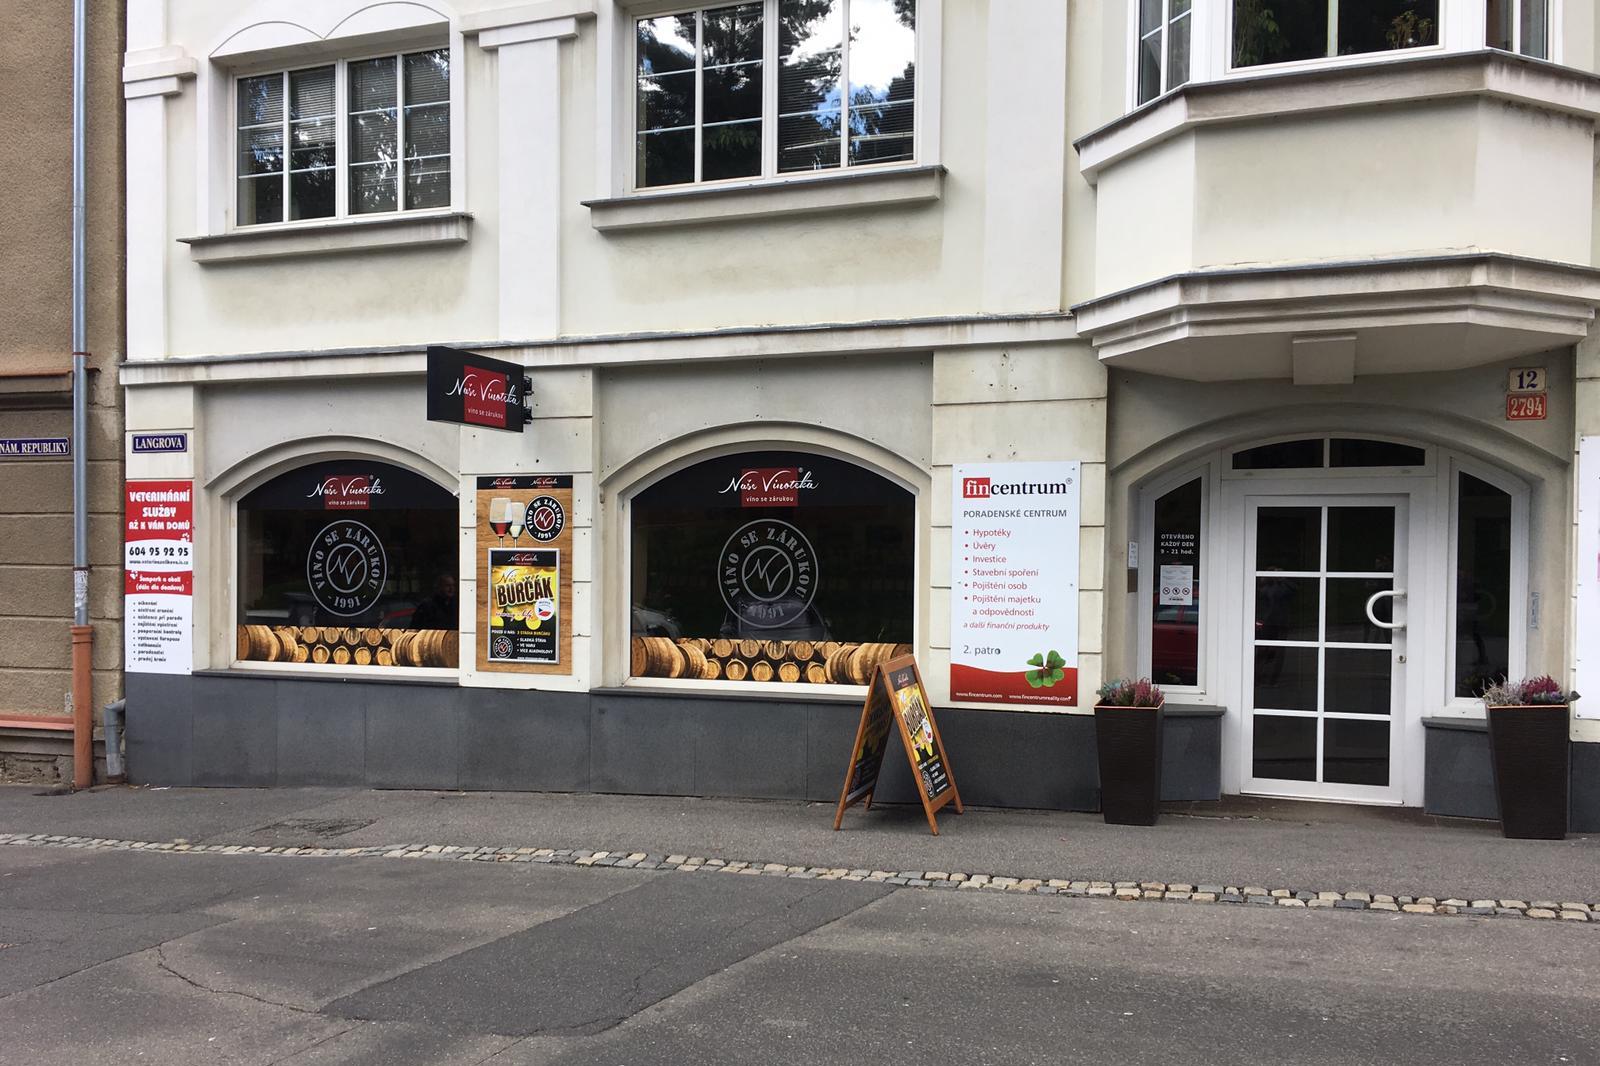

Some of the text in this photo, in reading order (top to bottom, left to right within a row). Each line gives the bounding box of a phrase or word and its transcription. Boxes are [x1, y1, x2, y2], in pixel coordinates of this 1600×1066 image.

[446, 374, 477, 397] Naše
[1517, 370, 1538, 389] 12
[1511, 398, 1542, 416] 2794
[0, 441, 67, 454] NÁM. REPUBLIKY
[135, 437, 183, 449] LANGROVA
[306, 477, 338, 497] Naše
[718, 471, 759, 493] Naše
[965, 480, 1067, 496] fincentrum
[129, 489, 190, 502] VETERINÁRNÍ
[142, 504, 176, 517] SLUŽBY
[963, 508, 1067, 518] PORADENSKÉ CENTRUM
[128, 520, 190, 530] AŽ K VÁM DOMŮ
[973, 529, 1011, 538] Hypotéky
[1160, 532, 1195, 540] OTEVŘENO
[129, 547, 189, 556] 604 95 92 95
[973, 541, 996, 551] Úvěry
[325, 529, 340, 546] SE
[345, 527, 381, 590] ZÁRUKOU
[740, 530, 759, 548] SE
[767, 528, 811, 599] ZÁRUKOU
[973, 555, 1007, 563] Investice
[973, 568, 1039, 579] Stavební spoření
[496, 573, 554, 606] BURČÁK
[972, 581, 1027, 591] Pojištění osob
[334, 596, 361, 609] 1991
[972, 594, 1041, 605] Pojištění majetku
[979, 608, 1035, 617] odpovědnosti
[986, 622, 1015, 630] finanční
[1016, 623, 1050, 632] produkty
[963, 645, 1001, 656] 2. patro
